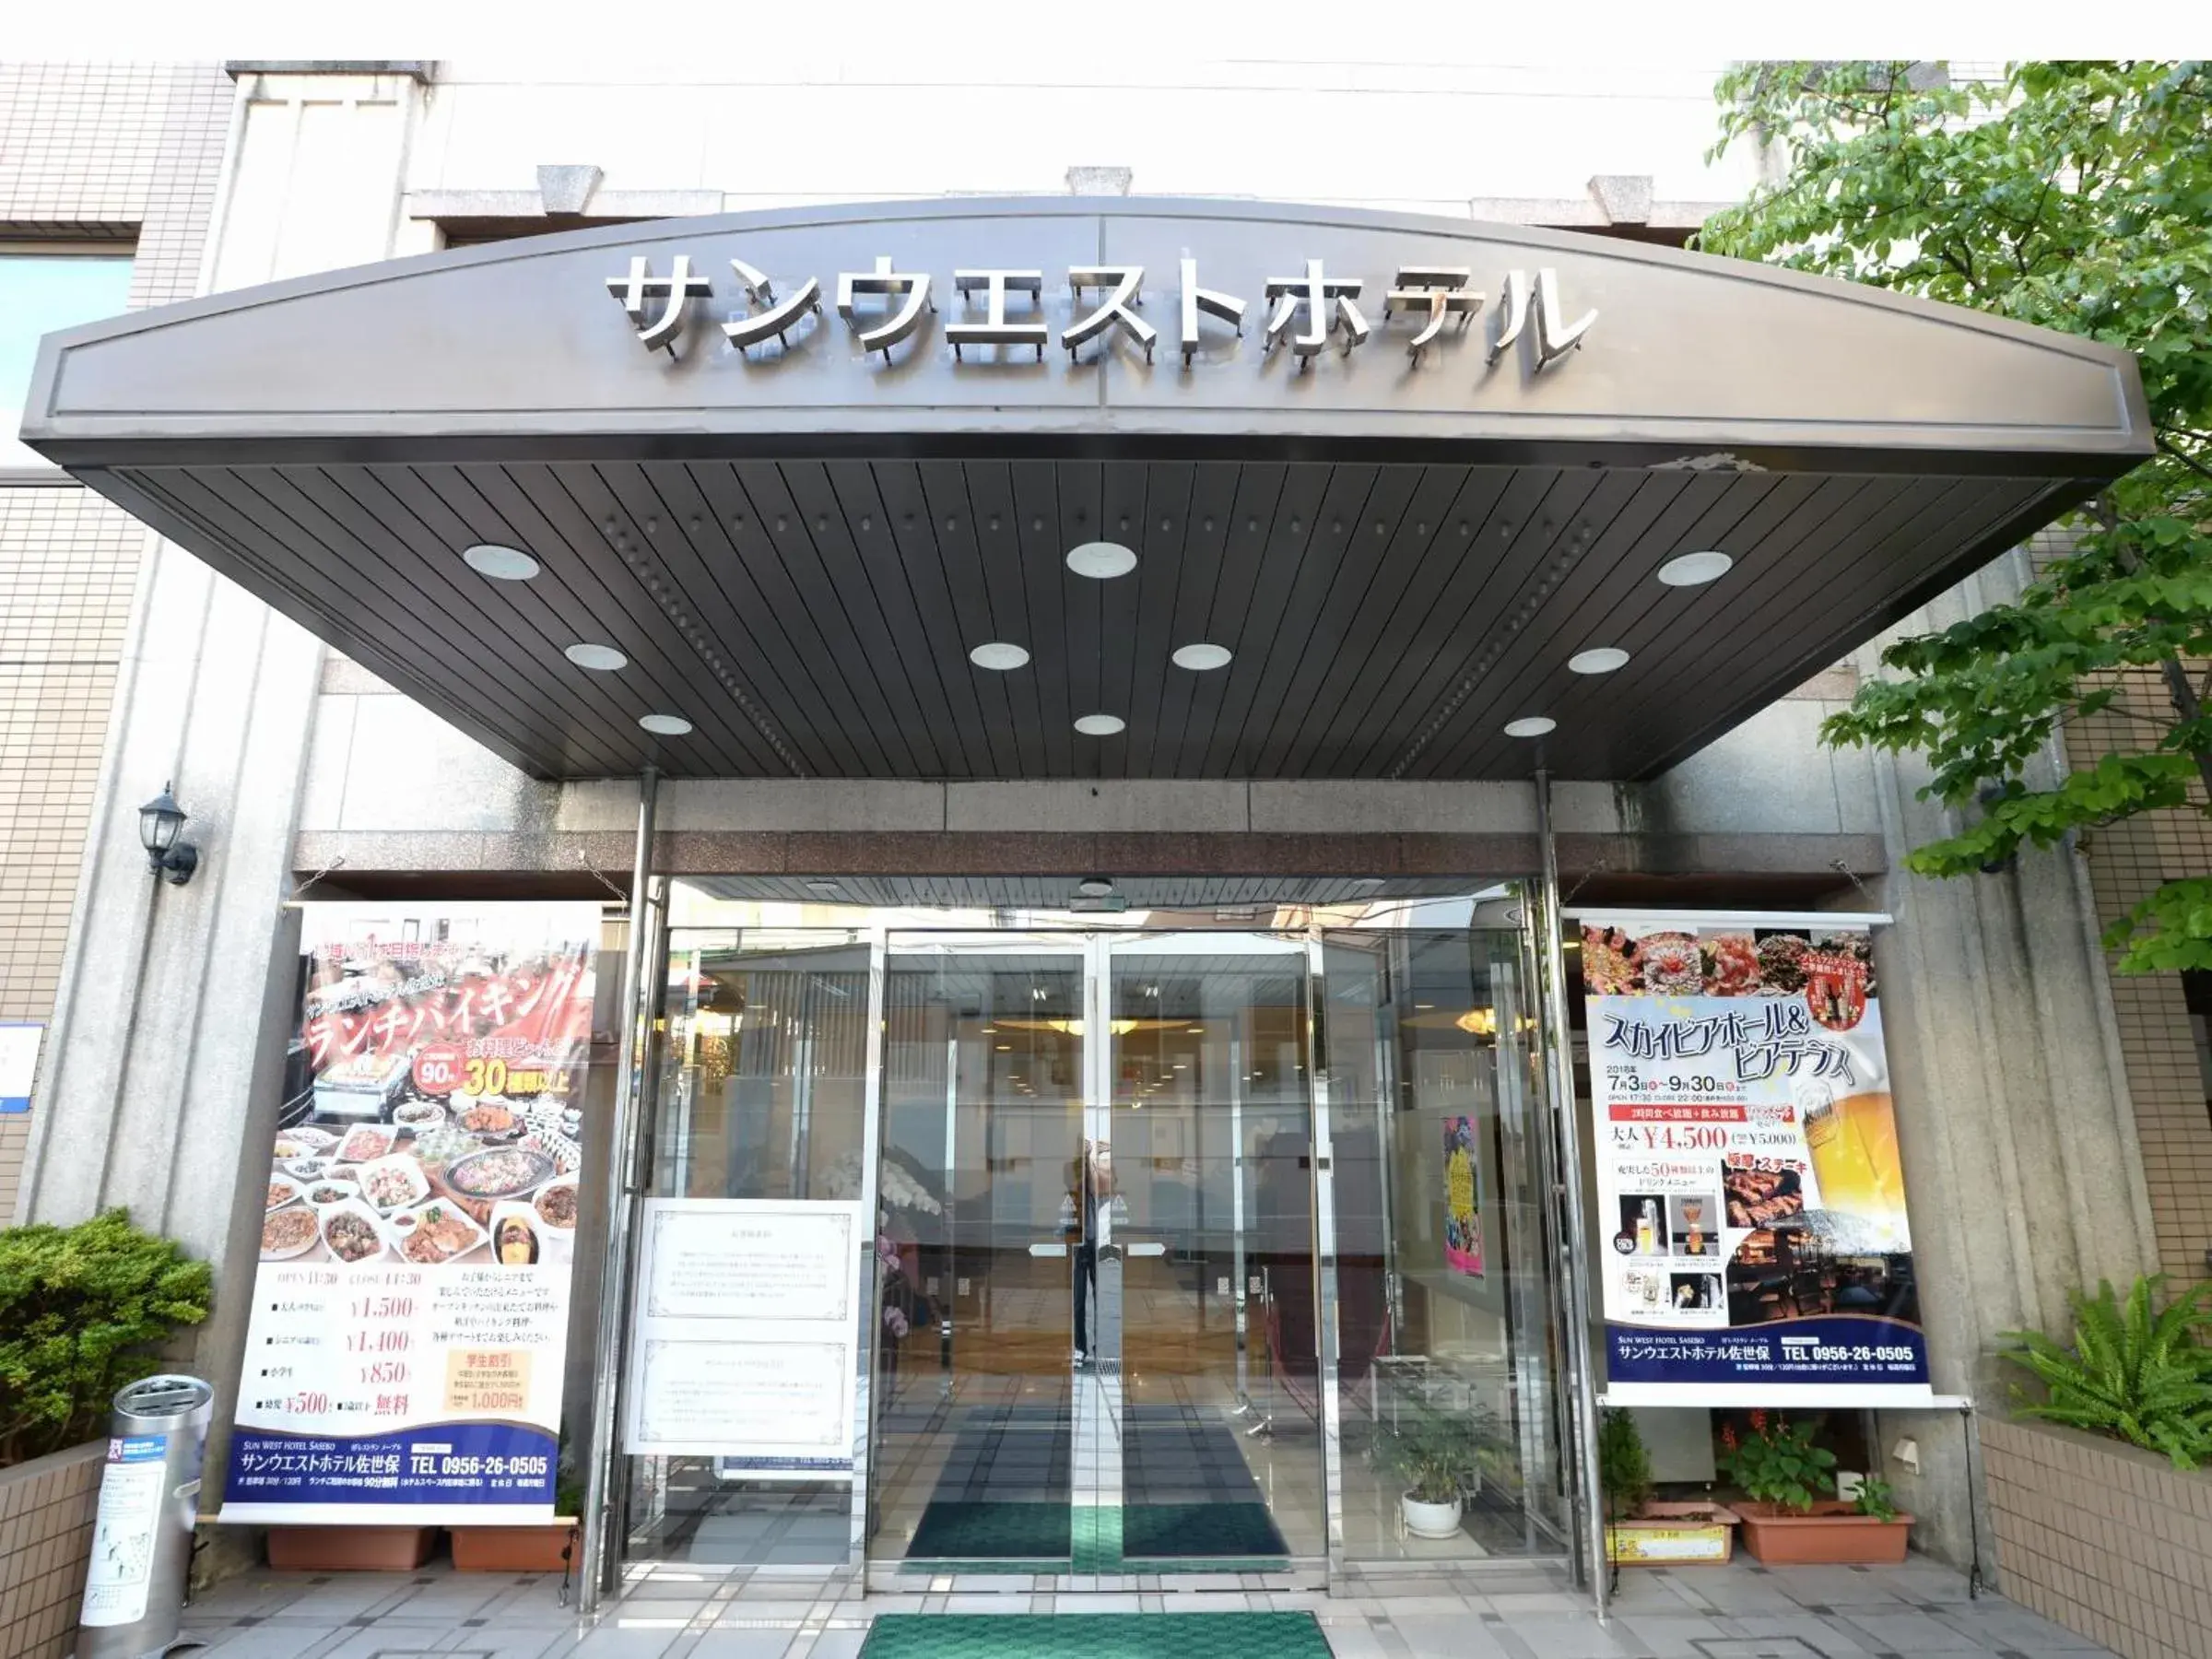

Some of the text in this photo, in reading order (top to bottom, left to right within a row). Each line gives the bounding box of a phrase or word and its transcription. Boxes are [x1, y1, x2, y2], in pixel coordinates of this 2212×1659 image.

[605, 255, 1599, 364] サンウエストホテル
[308, 970, 576, 1067] ランチバイキング
[1734, 1038, 1855, 1086] ビアテラス
[1611, 1125, 1639, 1142] 大人
[1634, 1336, 1654, 1345] WEST
[1618, 1345, 1771, 1361] サンウエストホテル佐世保
[1782, 1346, 1914, 1361] TEL 0956-26-0505
[374, 1393, 408, 1416] 無料
[242, 1441, 261, 1451] SUN
[263, 1441, 283, 1451] WEST
[284, 1441, 307, 1451] HOTEL
[241, 1453, 401, 1475] サンウエストホテル佐世保
[410, 1455, 547, 1476] TEL 0956-26-0505
